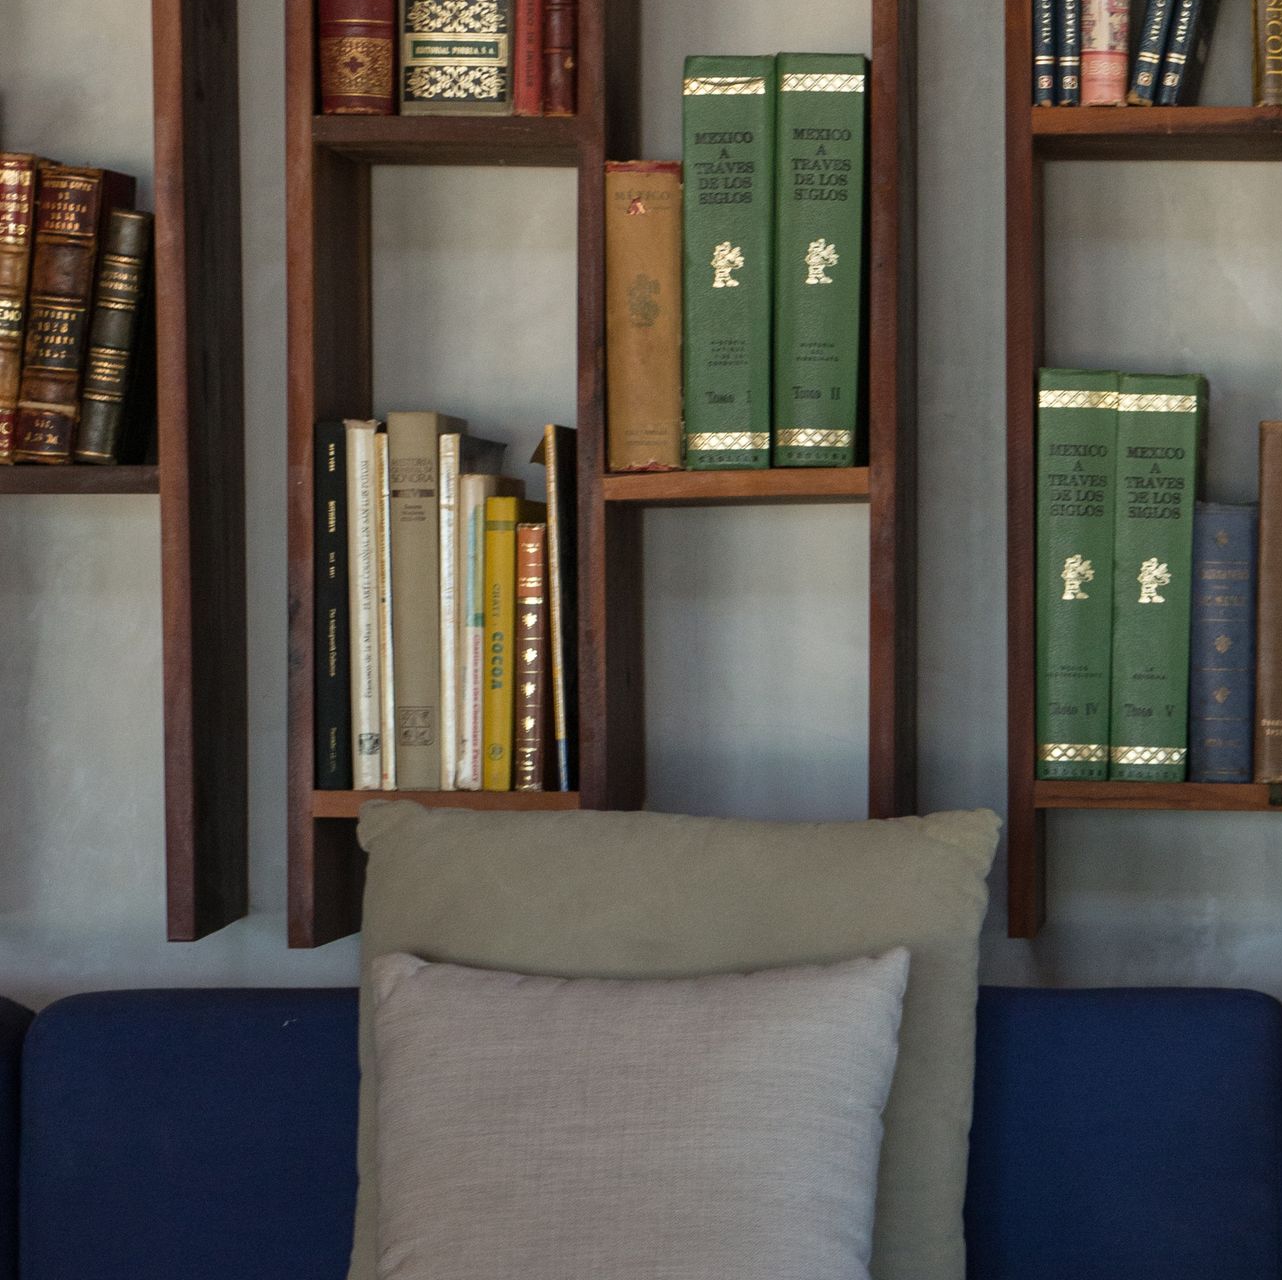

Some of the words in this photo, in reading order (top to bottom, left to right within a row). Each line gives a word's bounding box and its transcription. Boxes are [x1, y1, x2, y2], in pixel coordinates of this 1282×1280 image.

[1040, 13, 1052, 44] ATLAS
[1064, 16, 1076, 45] ATLAS
[1150, 12, 1165, 42] ATLAS
[1175, 12, 1190, 43] ATLAS
[694, 131, 753, 146] MEXICO
[792, 127, 852, 142] MEXICO
[719, 148, 730, 159] A
[815, 144, 827, 156] A
[694, 161, 755, 176] TRAVES
[791, 158, 851, 172] TRAVES
[699, 177, 722, 190] DE
[725, 176, 753, 190] LOS
[793, 174, 814, 186] DE
[818, 173, 849, 187] LOS
[699, 191, 753, 205] SIGLOS
[793, 188, 849, 202] SIGLOS
[705, 390, 735, 404] Tomo
[746, 389, 752, 403] I
[792, 385, 821, 400] Tomo
[830, 386, 841, 401] II
[1049, 444, 1108, 458] MEXICO
[1126, 446, 1185, 460] MEXICO
[1073, 459, 1083, 471] A
[1150, 462, 1161, 474] A
[1049, 474, 1108, 487] TRAVES
[1125, 476, 1186, 490] TRAVES
[1051, 490, 1071, 502] DE
[1076, 489, 1104, 503] LOS
[1128, 491, 1148, 504] DE
[1154, 491, 1182, 505] LOS
[1050, 504, 1104, 517] SIGLOS
[1128, 506, 1182, 520] SIGLOS
[491, 631, 504, 690] COCOA
[1049, 702, 1079, 716] Tomo
[1084, 702, 1099, 716] IV
[1124, 703, 1154, 717] Tomo
[1165, 703, 1175, 717] V
[472, 704, 481, 747] Chocolate
[471, 749, 480, 782] Factory
